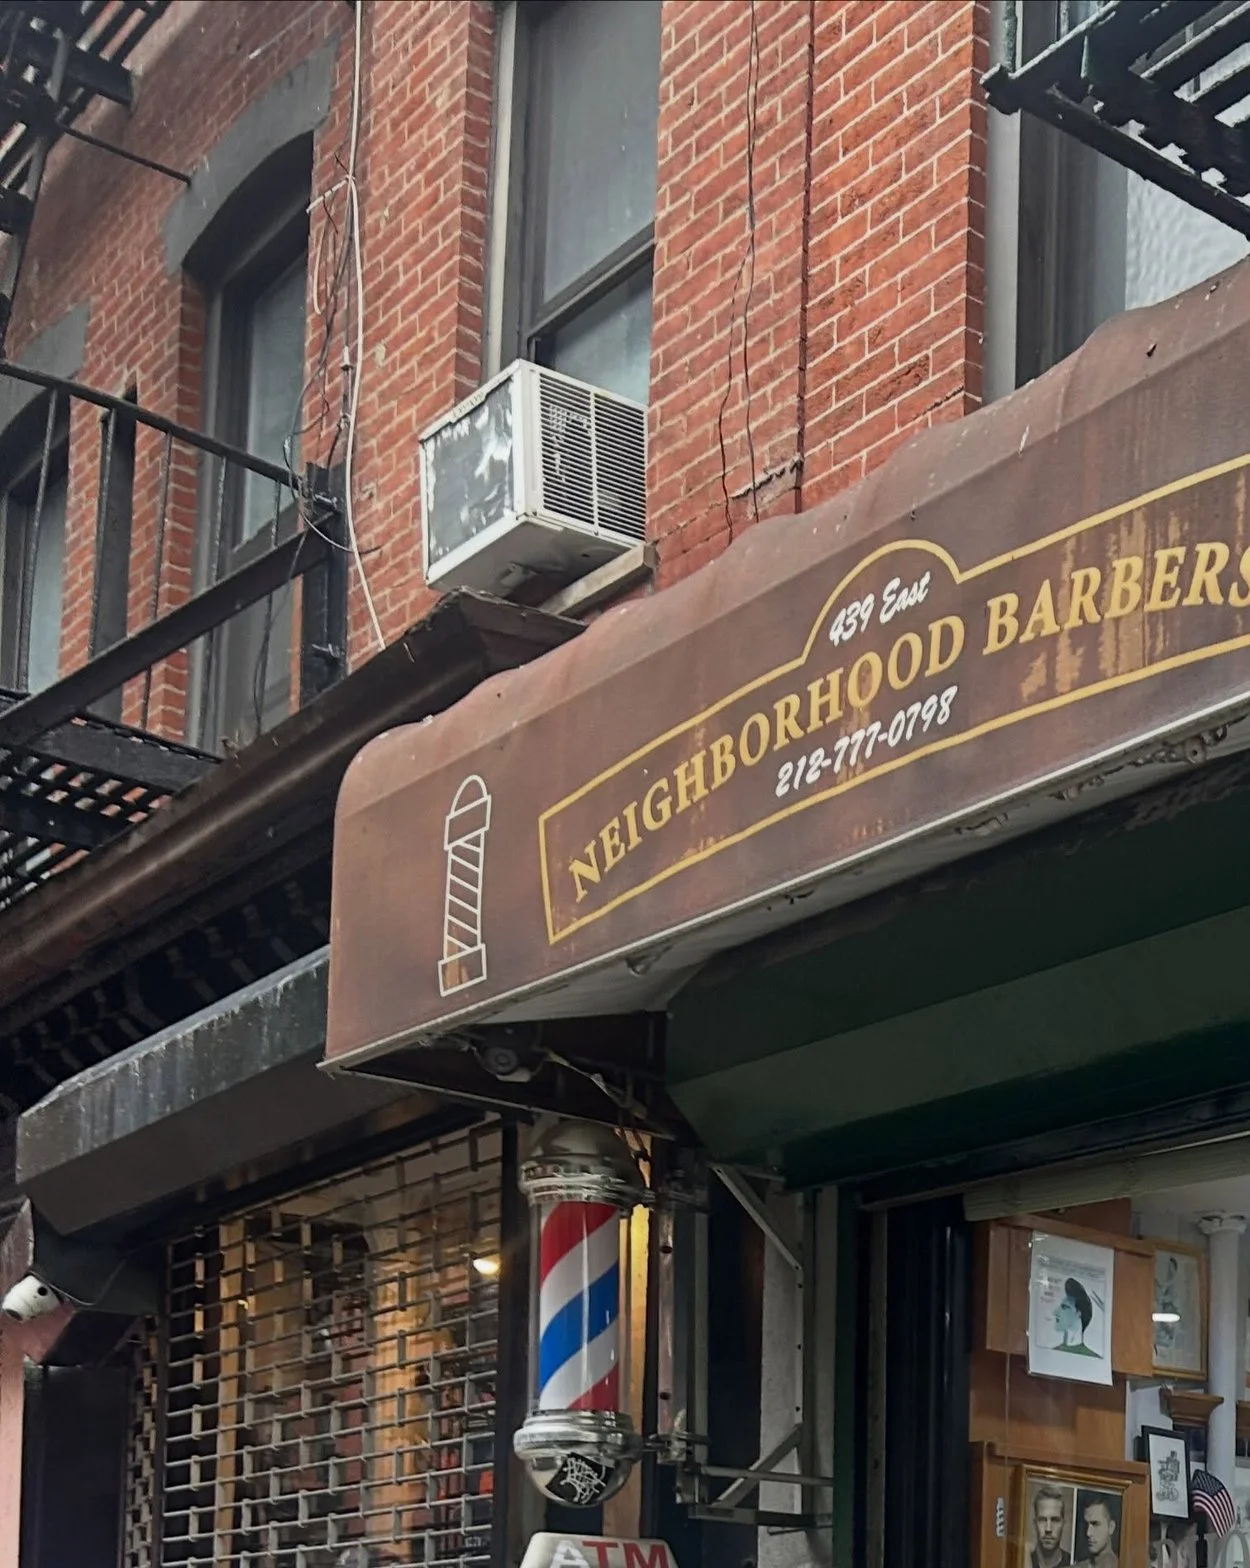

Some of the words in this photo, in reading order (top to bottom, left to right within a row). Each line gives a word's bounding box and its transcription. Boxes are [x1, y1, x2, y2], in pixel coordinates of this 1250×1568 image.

[829, 597, 875, 647] 439
[879, 570, 931, 620] East
[568, 615, 965, 902] NEIGHBORHOOD
[775, 686, 960, 798] 212-777-0798
